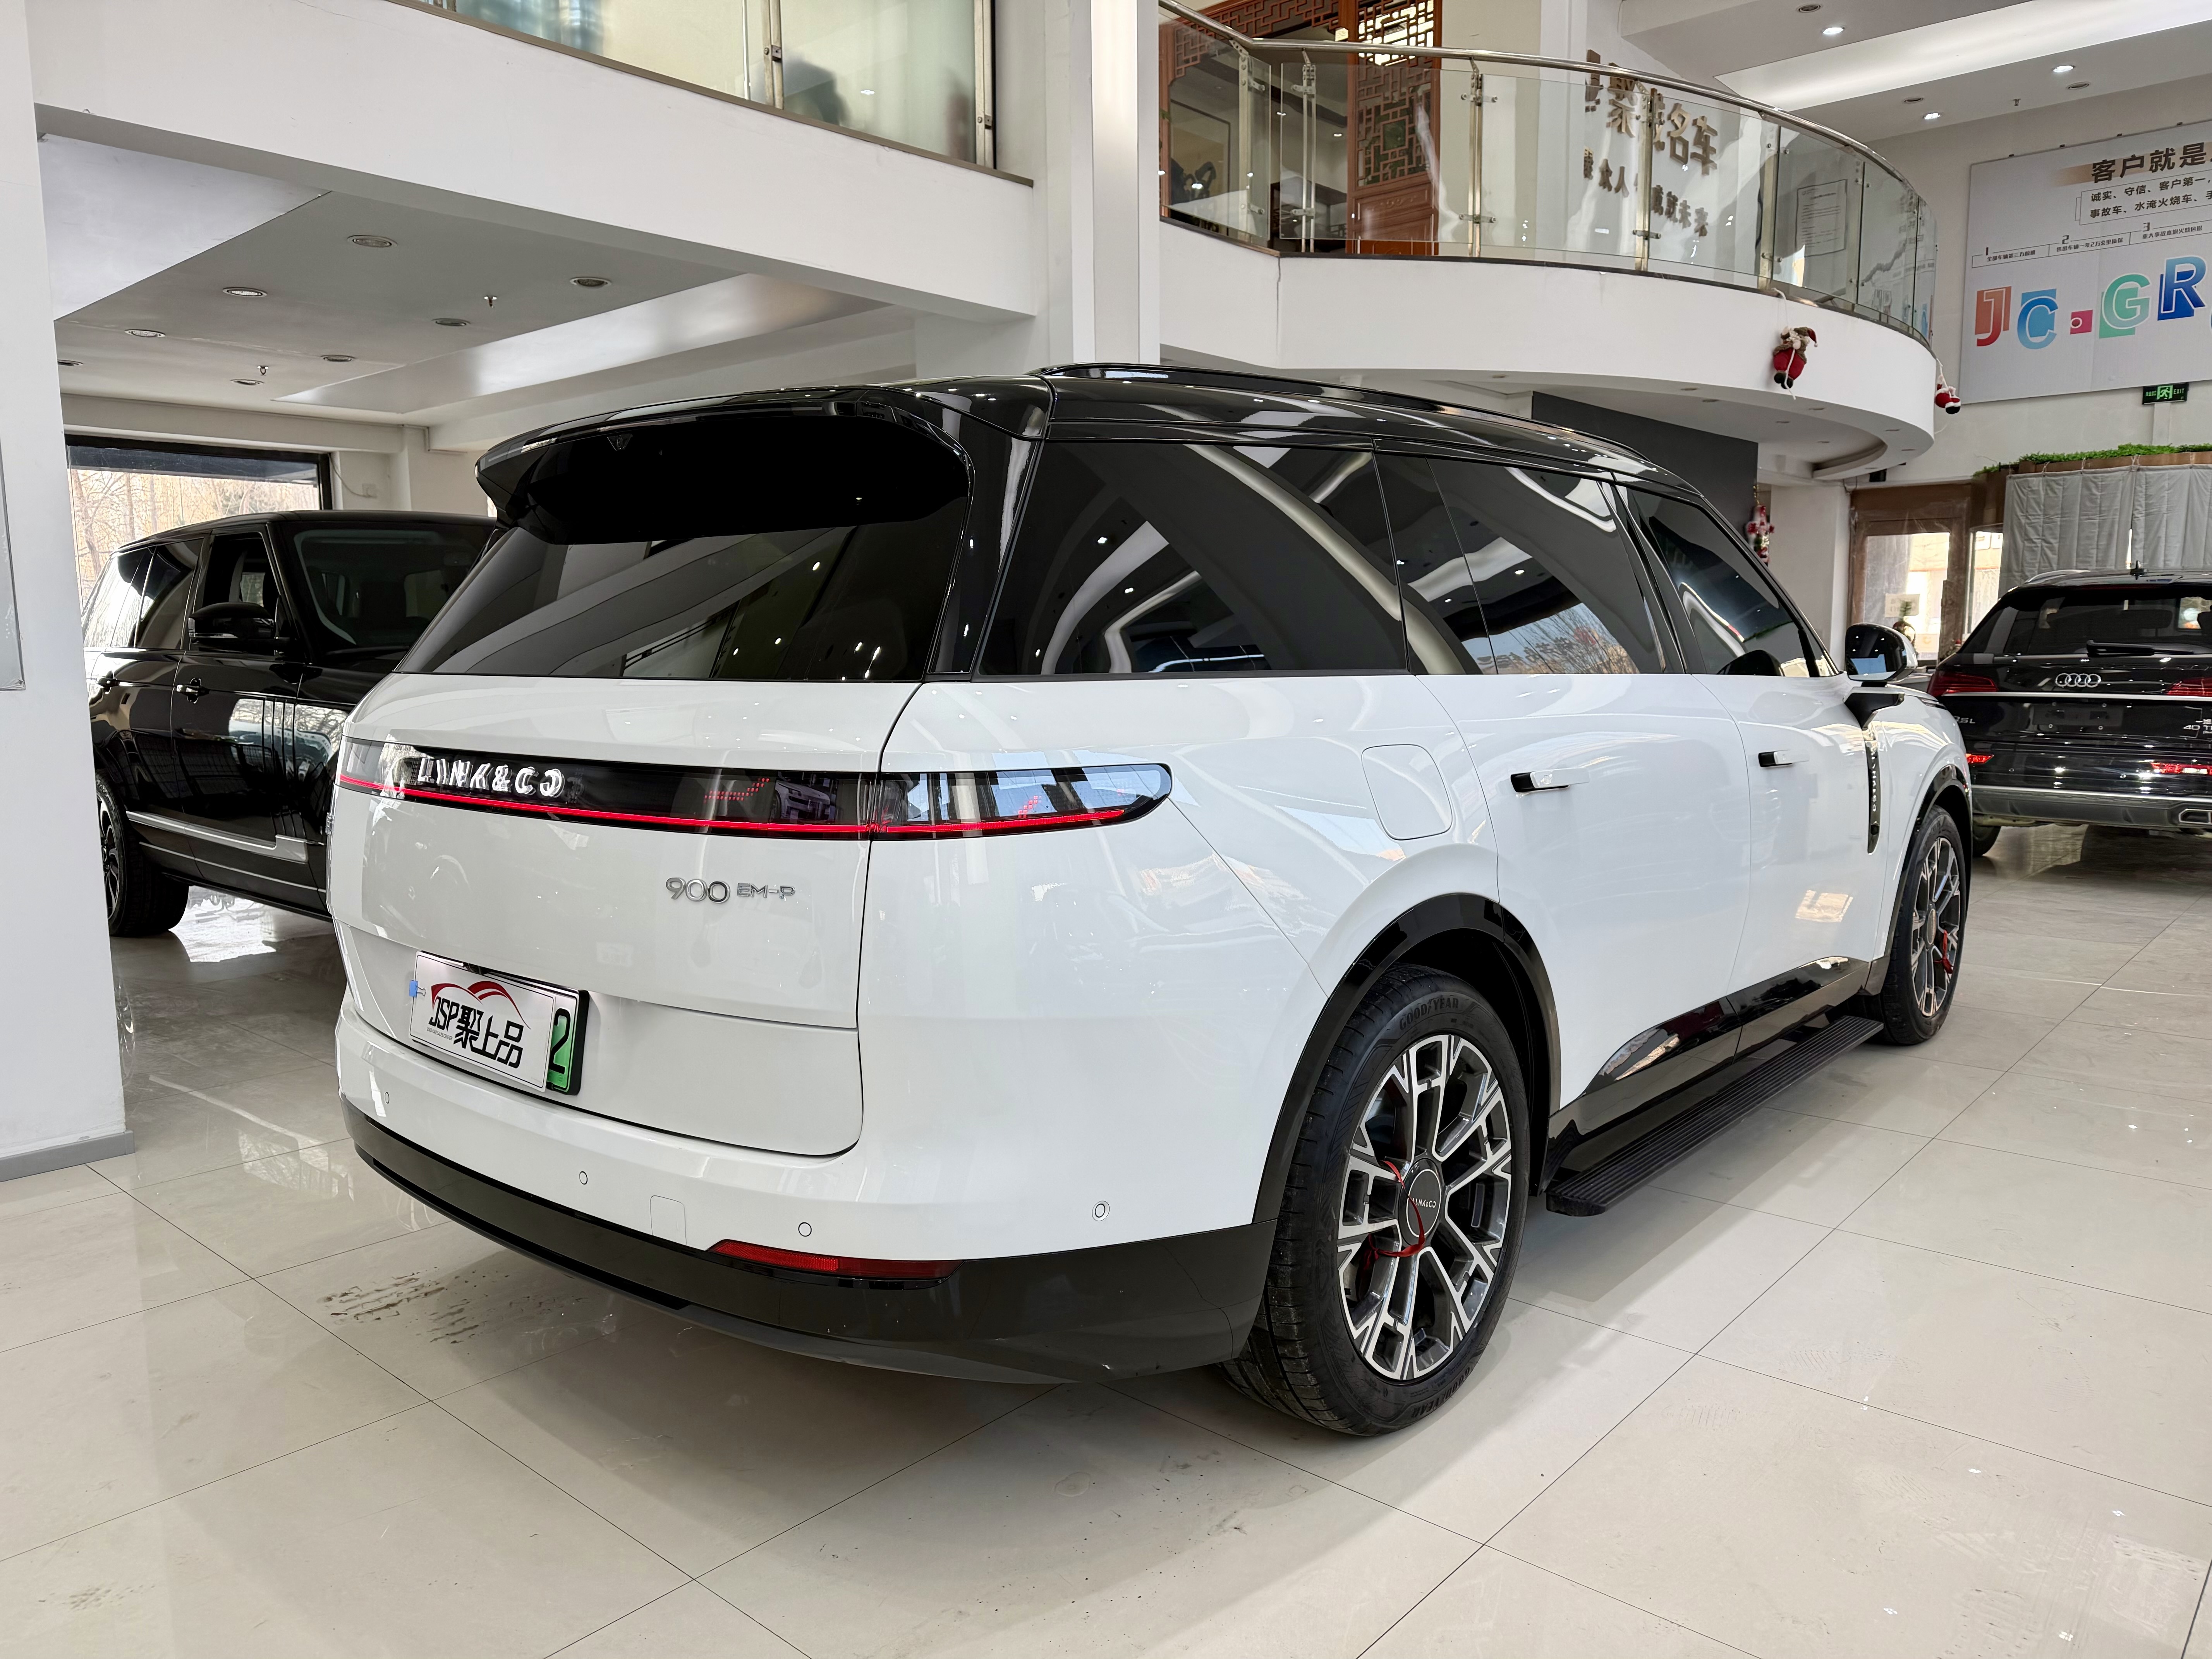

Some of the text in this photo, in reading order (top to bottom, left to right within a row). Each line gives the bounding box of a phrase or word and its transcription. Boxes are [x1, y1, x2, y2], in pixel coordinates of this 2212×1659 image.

[2091, 142, 2212, 183] 客户就是
[2062, 235, 2069, 244] 2
[665, 877, 796, 903] 900 EM-P
